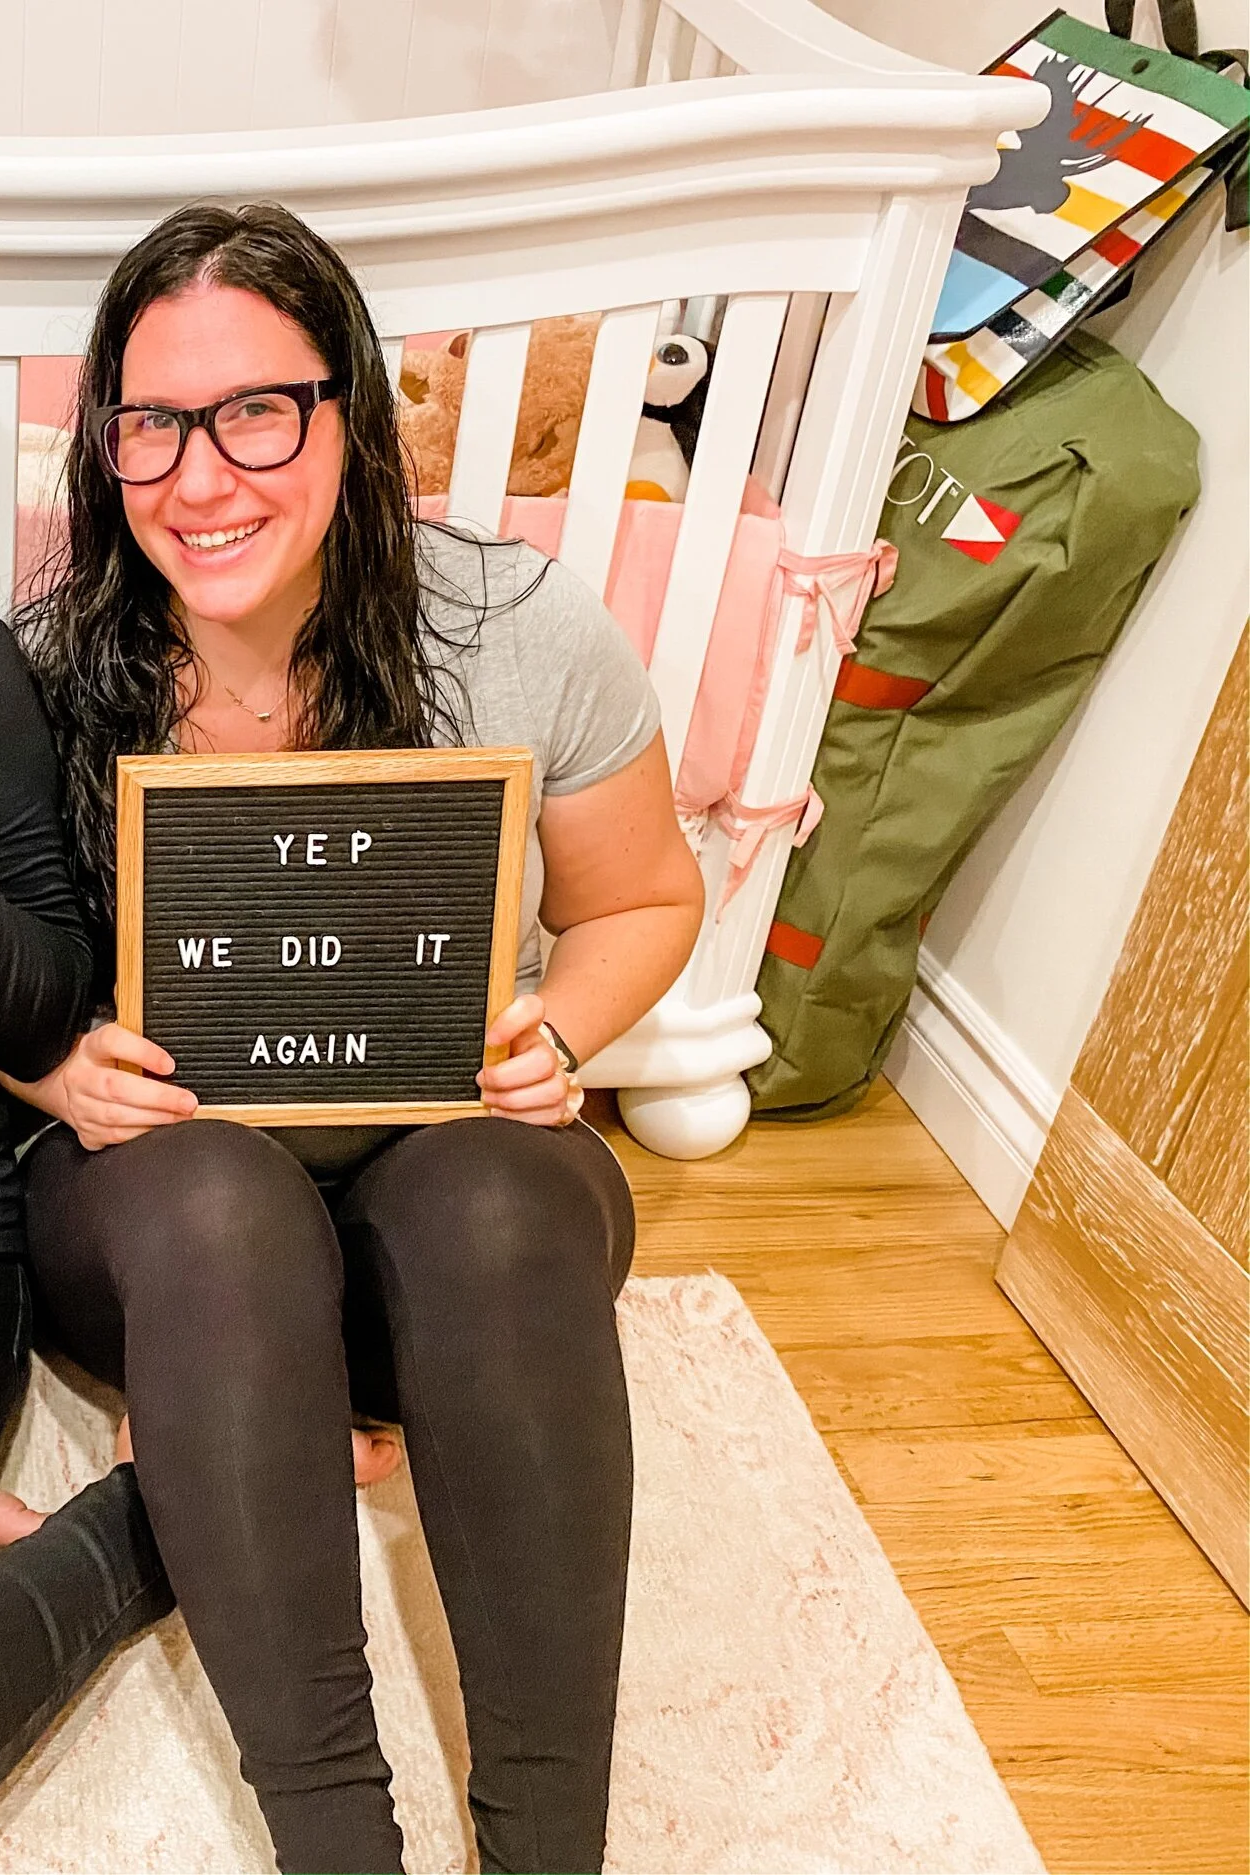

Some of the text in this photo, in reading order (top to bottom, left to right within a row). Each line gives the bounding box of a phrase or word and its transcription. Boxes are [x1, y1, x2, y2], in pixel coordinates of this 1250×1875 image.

[886, 434, 965, 525] OT
[177, 932, 451, 969] WE DID IT
[249, 1033, 367, 1065] AGAIN
